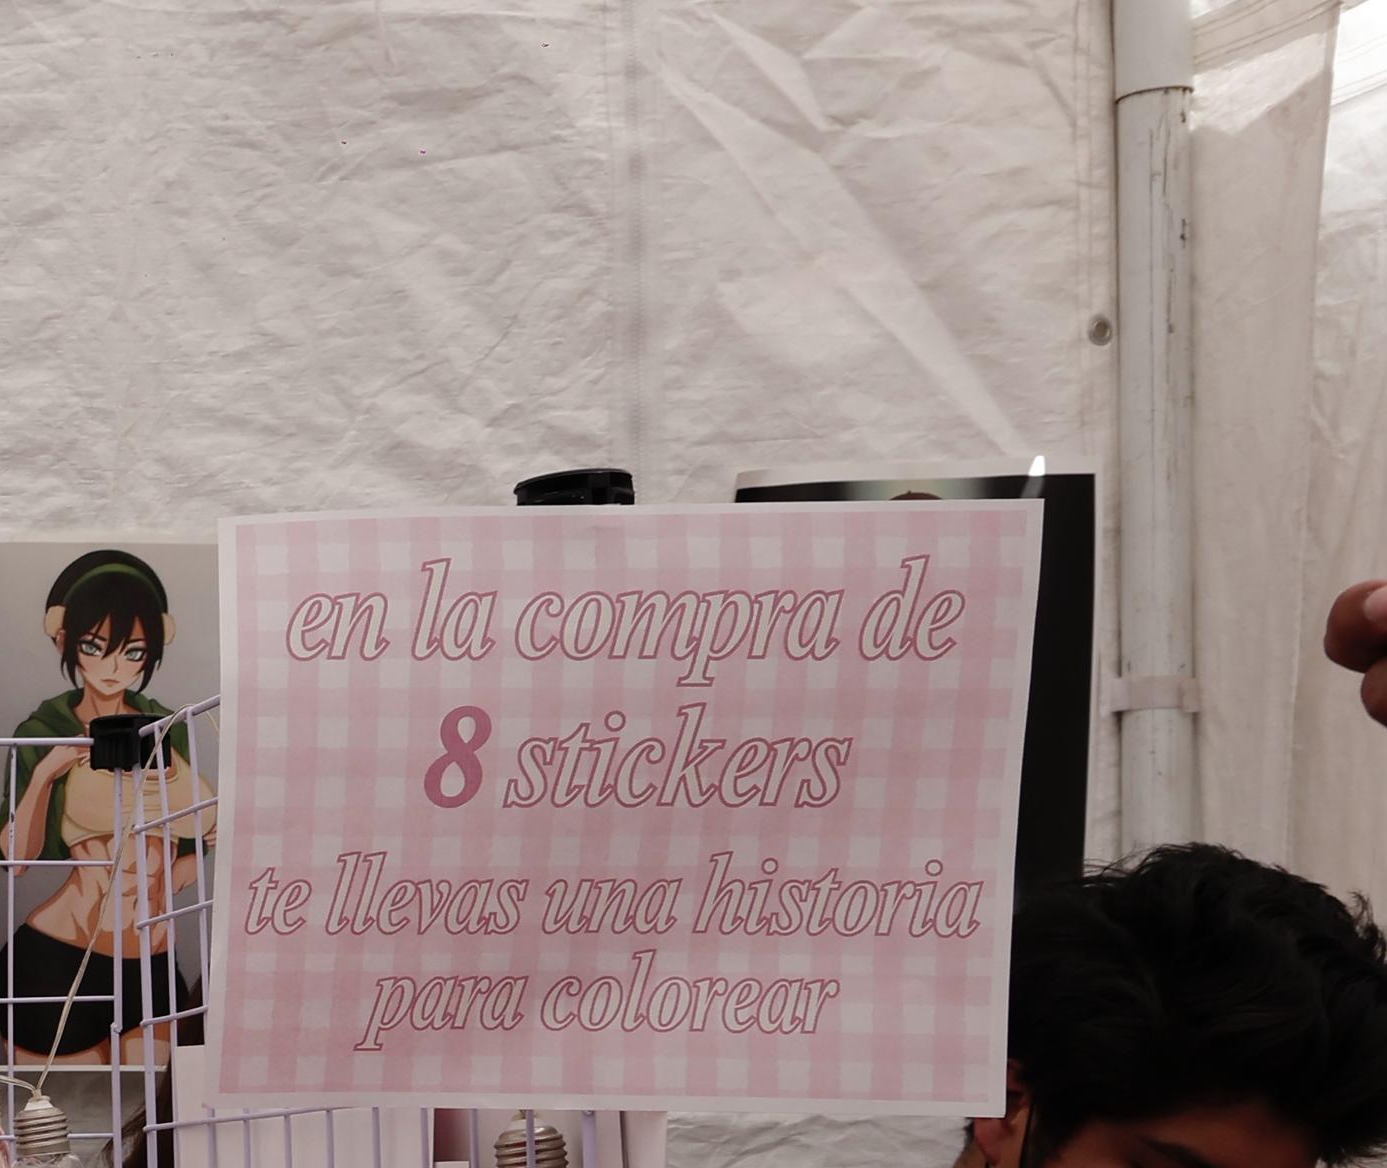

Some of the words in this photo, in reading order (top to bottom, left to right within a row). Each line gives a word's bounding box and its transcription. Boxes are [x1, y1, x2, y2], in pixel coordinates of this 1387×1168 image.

[286, 589, 392, 663] en
[413, 558, 498, 662] la
[515, 587, 846, 687] compra
[859, 554, 967, 663] de
[423, 705, 493, 810] 8
[503, 702, 854, 810] stickers
[244, 866, 313, 936] te
[324, 851, 530, 936] llevas
[542, 876, 682, 936] una
[692, 851, 985, 941] historia
[353, 974, 528, 1053] para
[539, 949, 840, 1036] colorear
